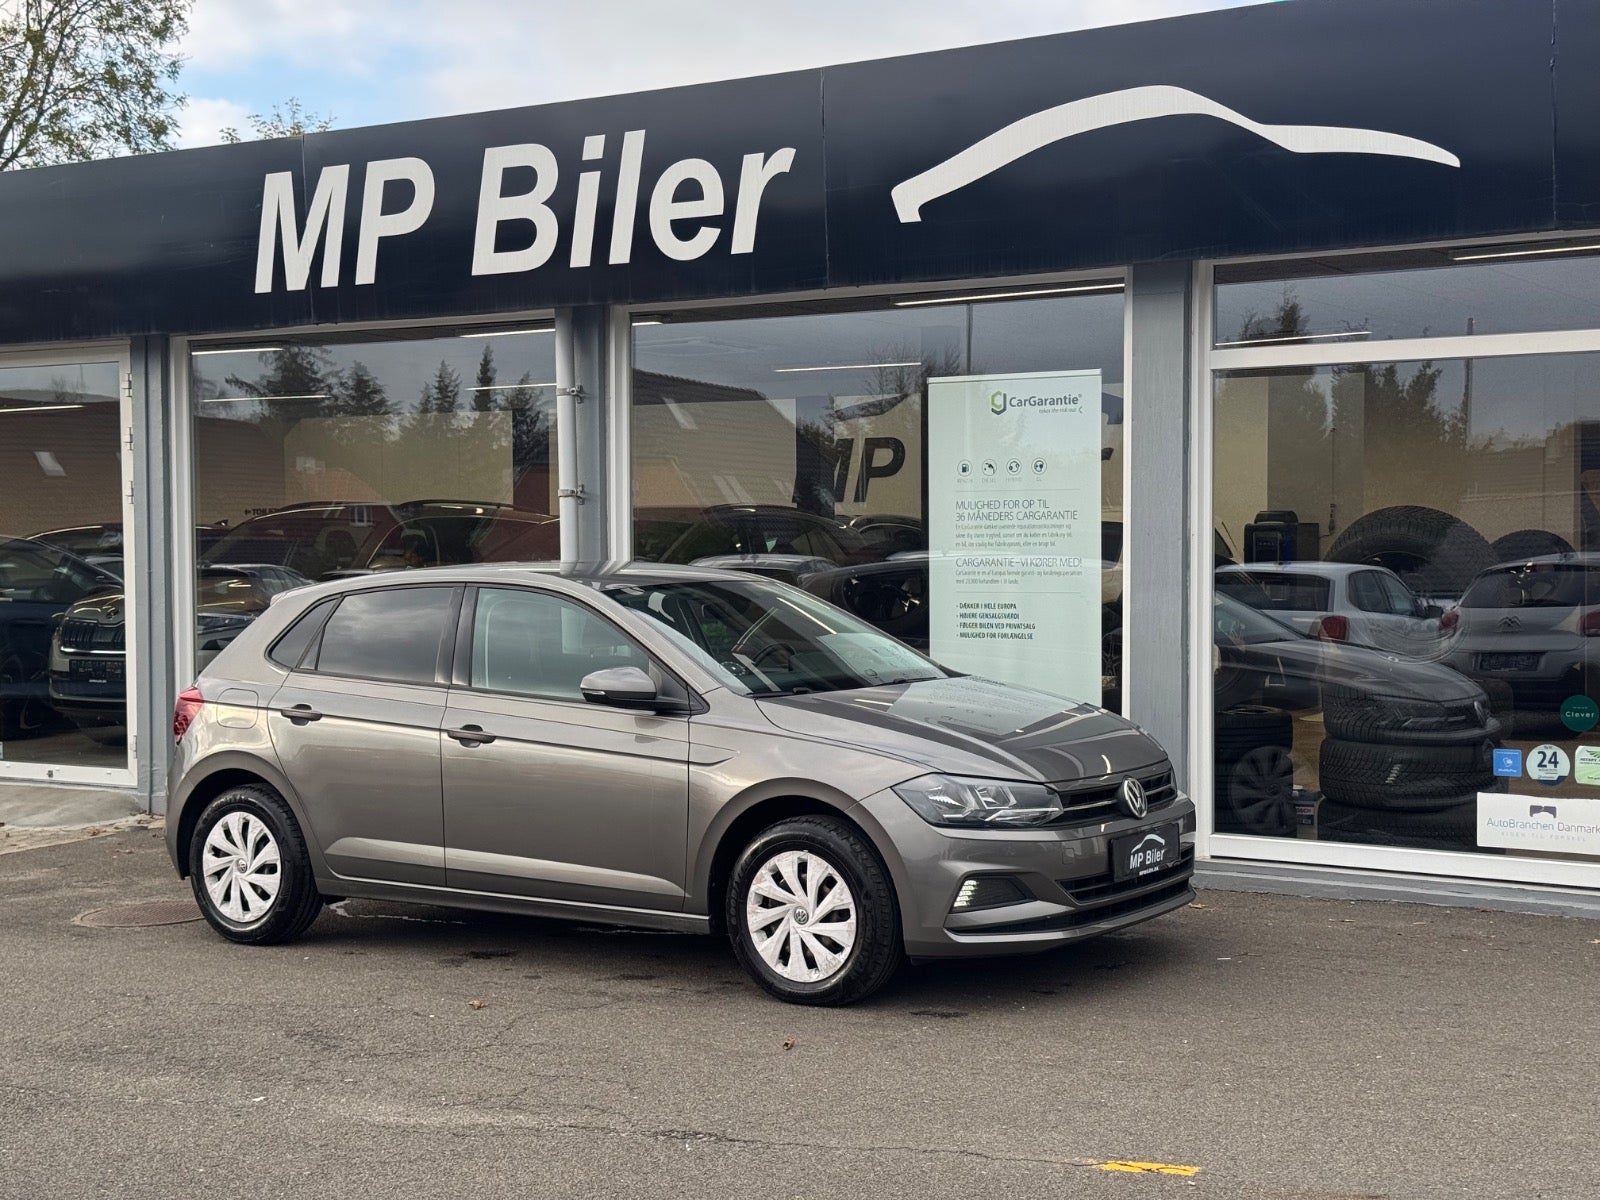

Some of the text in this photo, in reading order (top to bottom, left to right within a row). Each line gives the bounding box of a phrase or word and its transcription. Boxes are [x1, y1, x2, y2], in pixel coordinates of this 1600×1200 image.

[254, 129, 797, 294] MP Biler
[955, 499, 1050, 511] MULIGHED FOR OP TIL
[955, 510, 1079, 522] 36 MÅNEDERS CARGARANTIE
[1030, 557, 1058, 568] KØRER
[959, 602, 980, 610] DÆKKER
[984, 602, 997, 610] HELE
[997, 602, 1017, 610] EUROPA
[979, 622, 994, 630] BILEN
[994, 622, 1005, 630] VED
[1005, 622, 1036, 630] PRIVATSALG
[997, 632, 1034, 640] FORLÆNGELSE
[1536, 750, 1560, 769] 24
[1486, 817, 1600, 834] AutoBranchen Danmark
[1130, 848, 1167, 870] MP Biler
